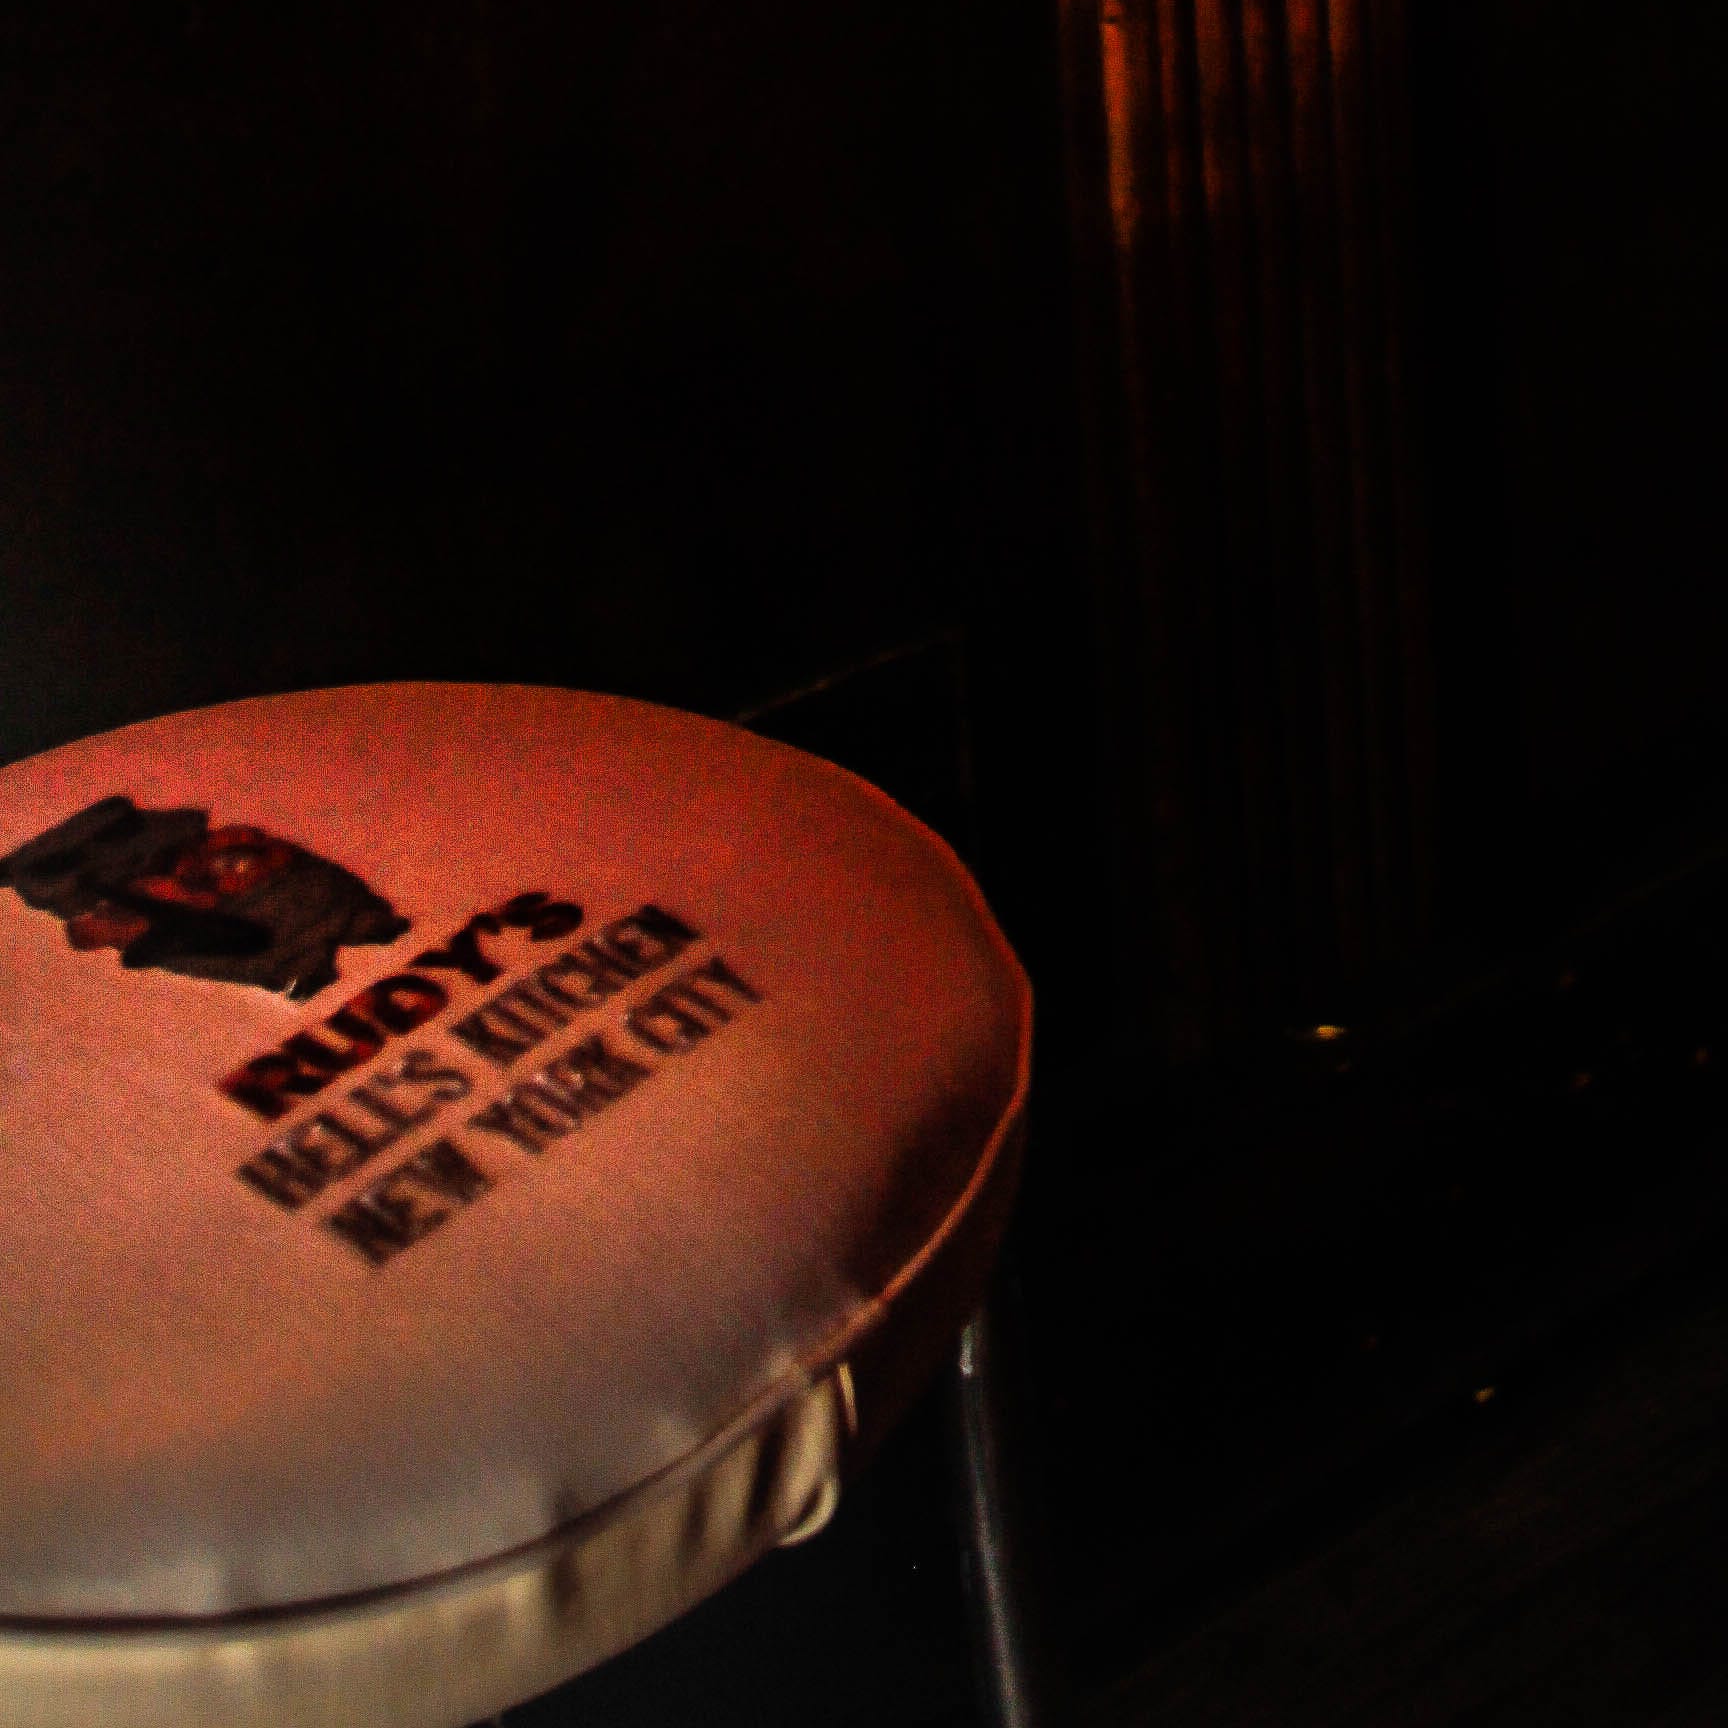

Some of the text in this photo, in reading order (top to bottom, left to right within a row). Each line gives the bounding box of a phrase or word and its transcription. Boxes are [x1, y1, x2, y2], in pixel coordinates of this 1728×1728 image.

[218, 891, 584, 1121] RUDY'S
[236, 904, 700, 1211] HELL'S KITCHEN
[325, 956, 764, 1270] NEW YORK CITY
